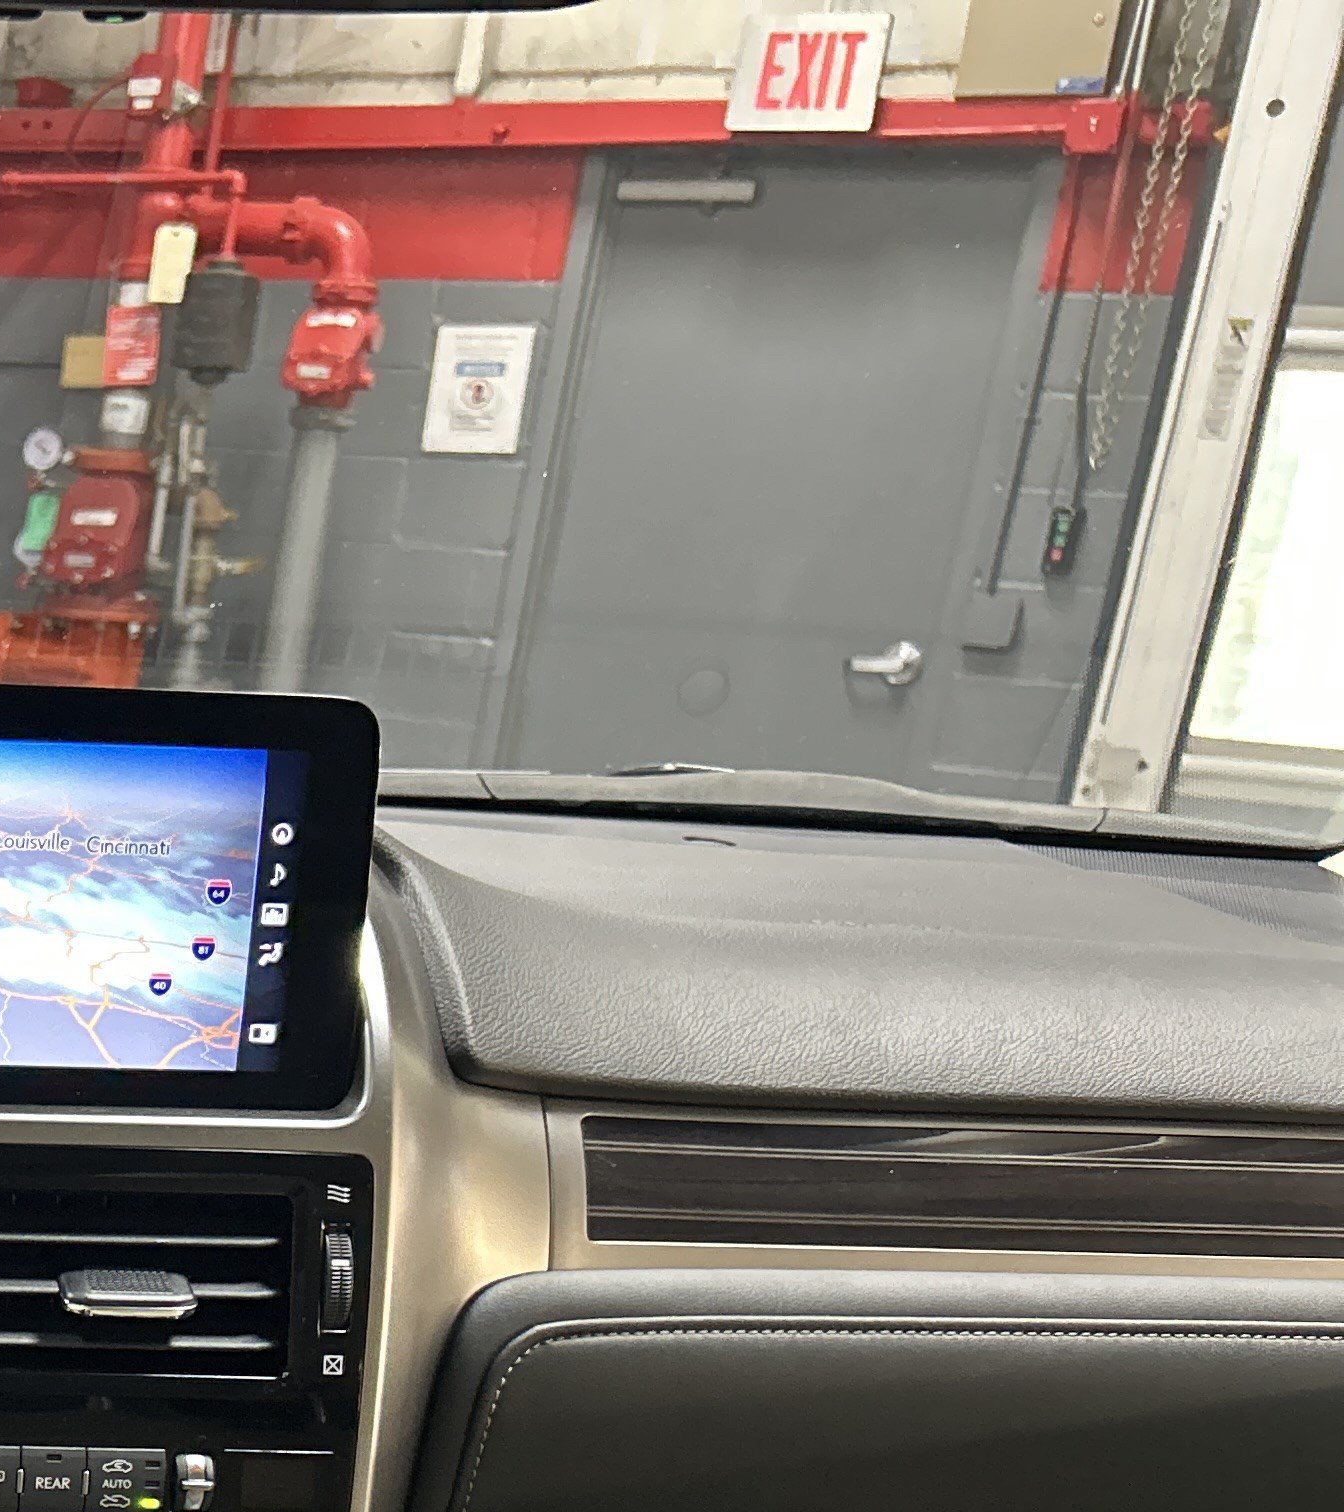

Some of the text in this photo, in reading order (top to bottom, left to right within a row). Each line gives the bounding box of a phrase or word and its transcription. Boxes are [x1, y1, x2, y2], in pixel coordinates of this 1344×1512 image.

[755, 31, 868, 111] EXIT
[86, 836, 172, 856] Cincinnati
[212, 889, 225, 899] 64
[153, 981, 167, 991] 40
[35, 1476, 71, 1491] REAR
[102, 1478, 132, 1490] AUTO
